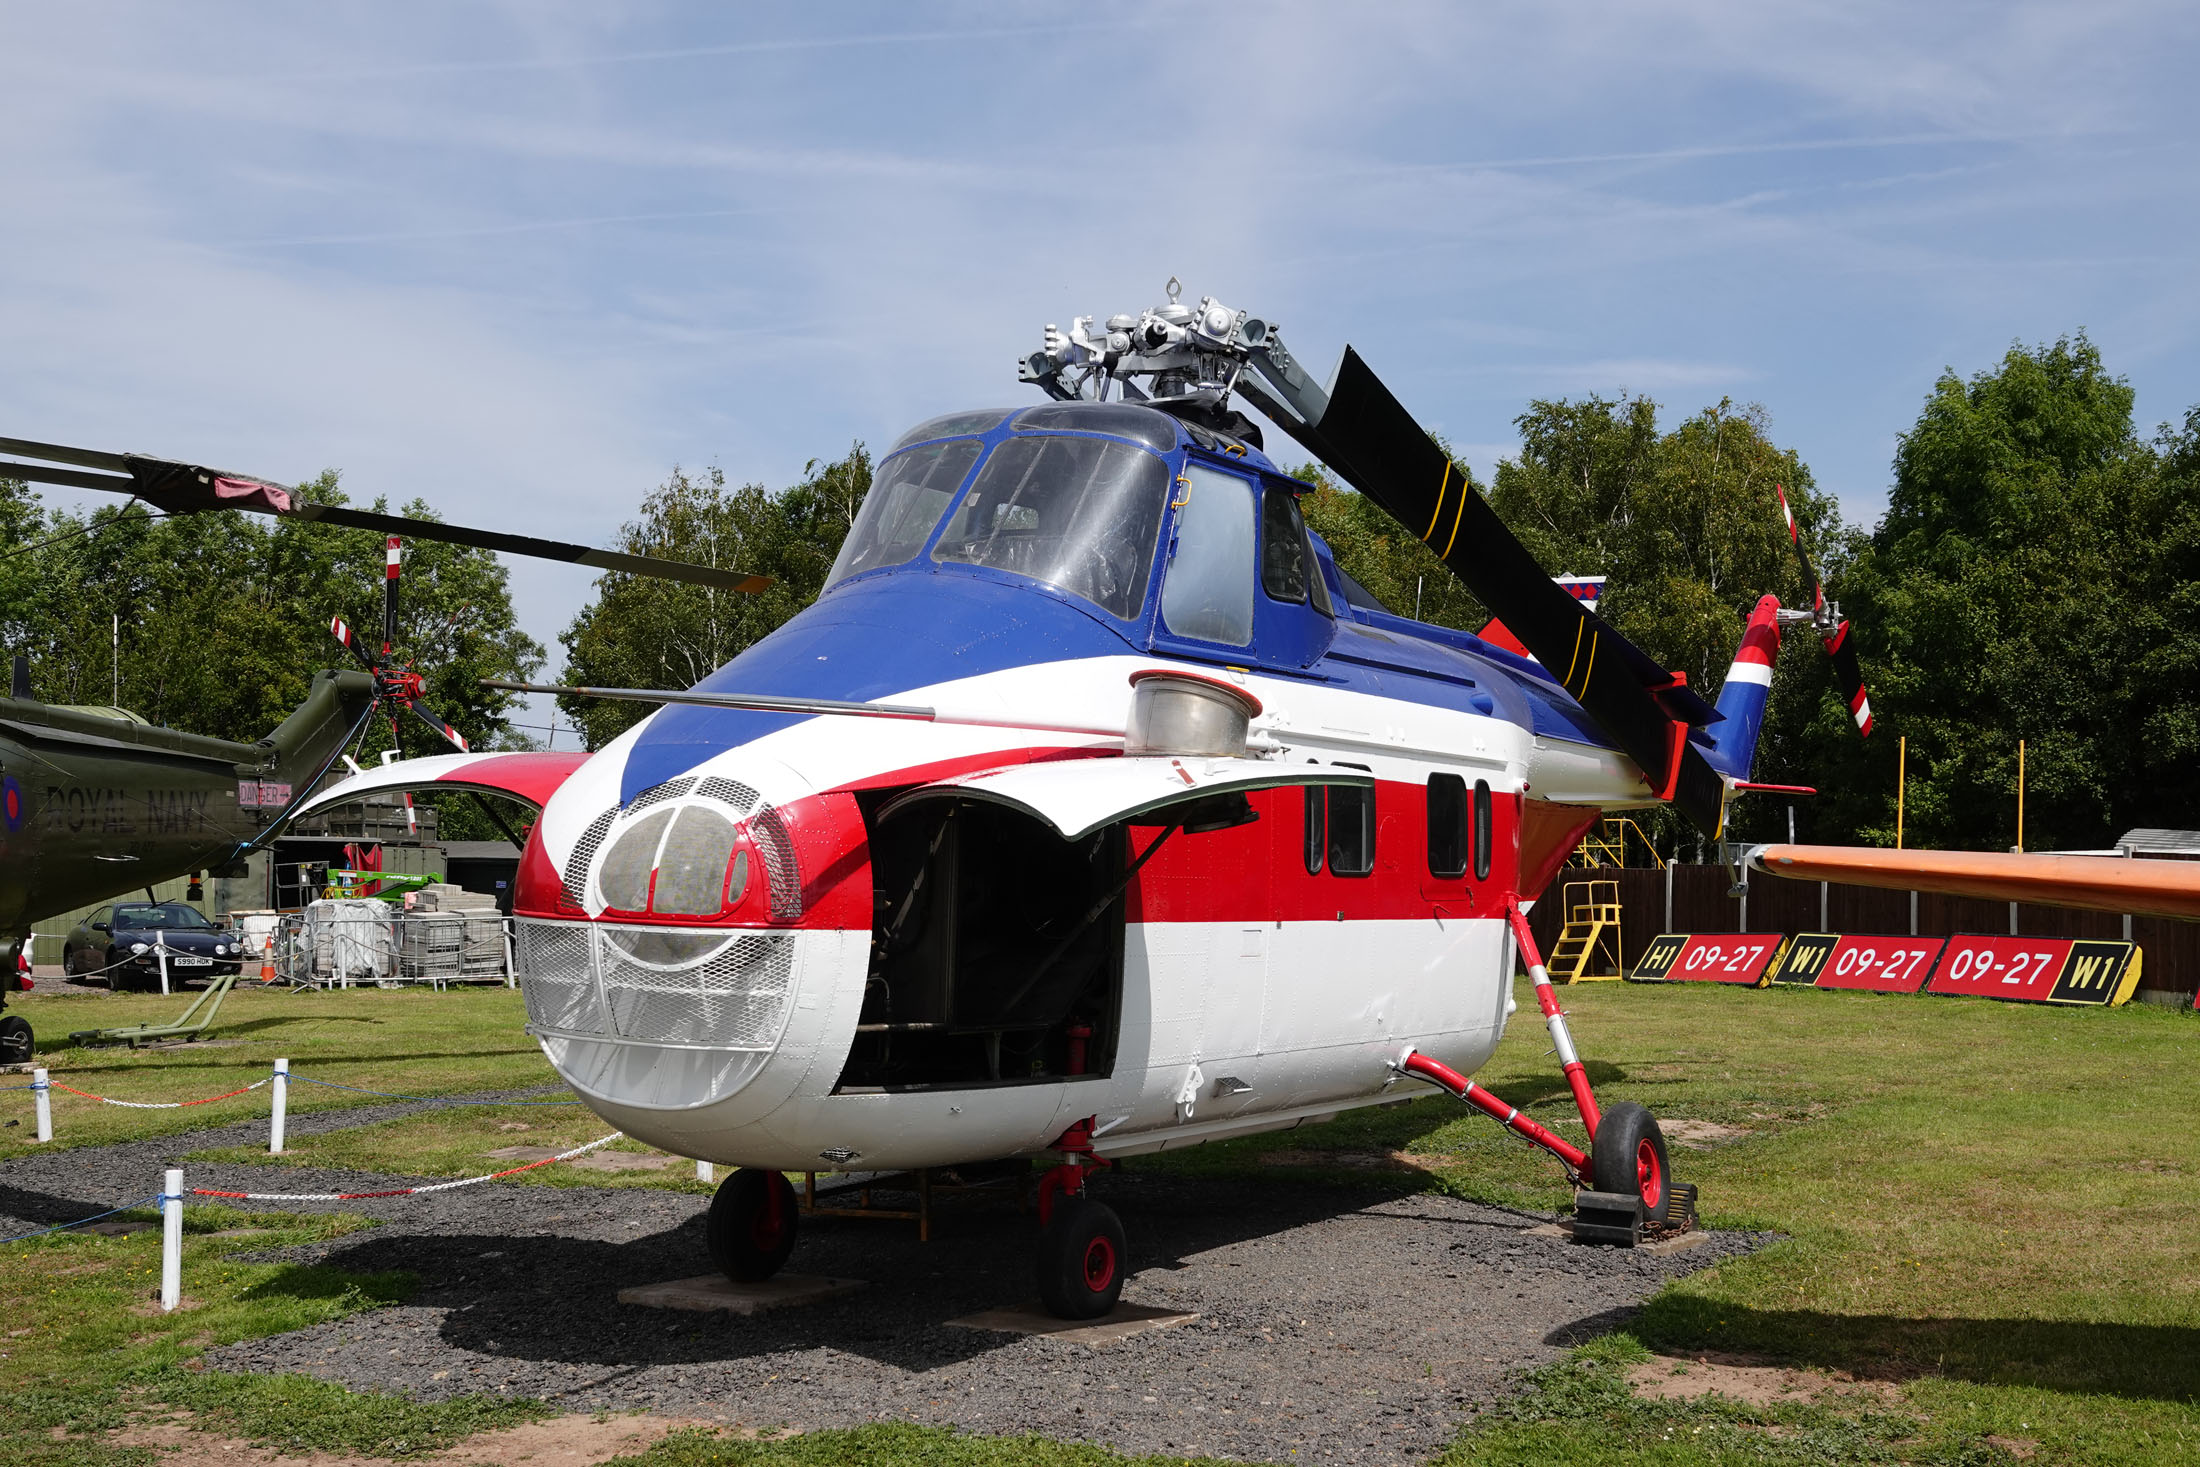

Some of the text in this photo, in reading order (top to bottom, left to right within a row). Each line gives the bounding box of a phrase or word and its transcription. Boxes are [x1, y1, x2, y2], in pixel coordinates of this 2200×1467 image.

[47, 787, 209, 833] ROYAL NAVY
[1644, 945, 1765, 972] H1 09-27
[1789, 946, 1926, 980] W1 09-27
[1949, 948, 2115, 990] 09-27 W1
